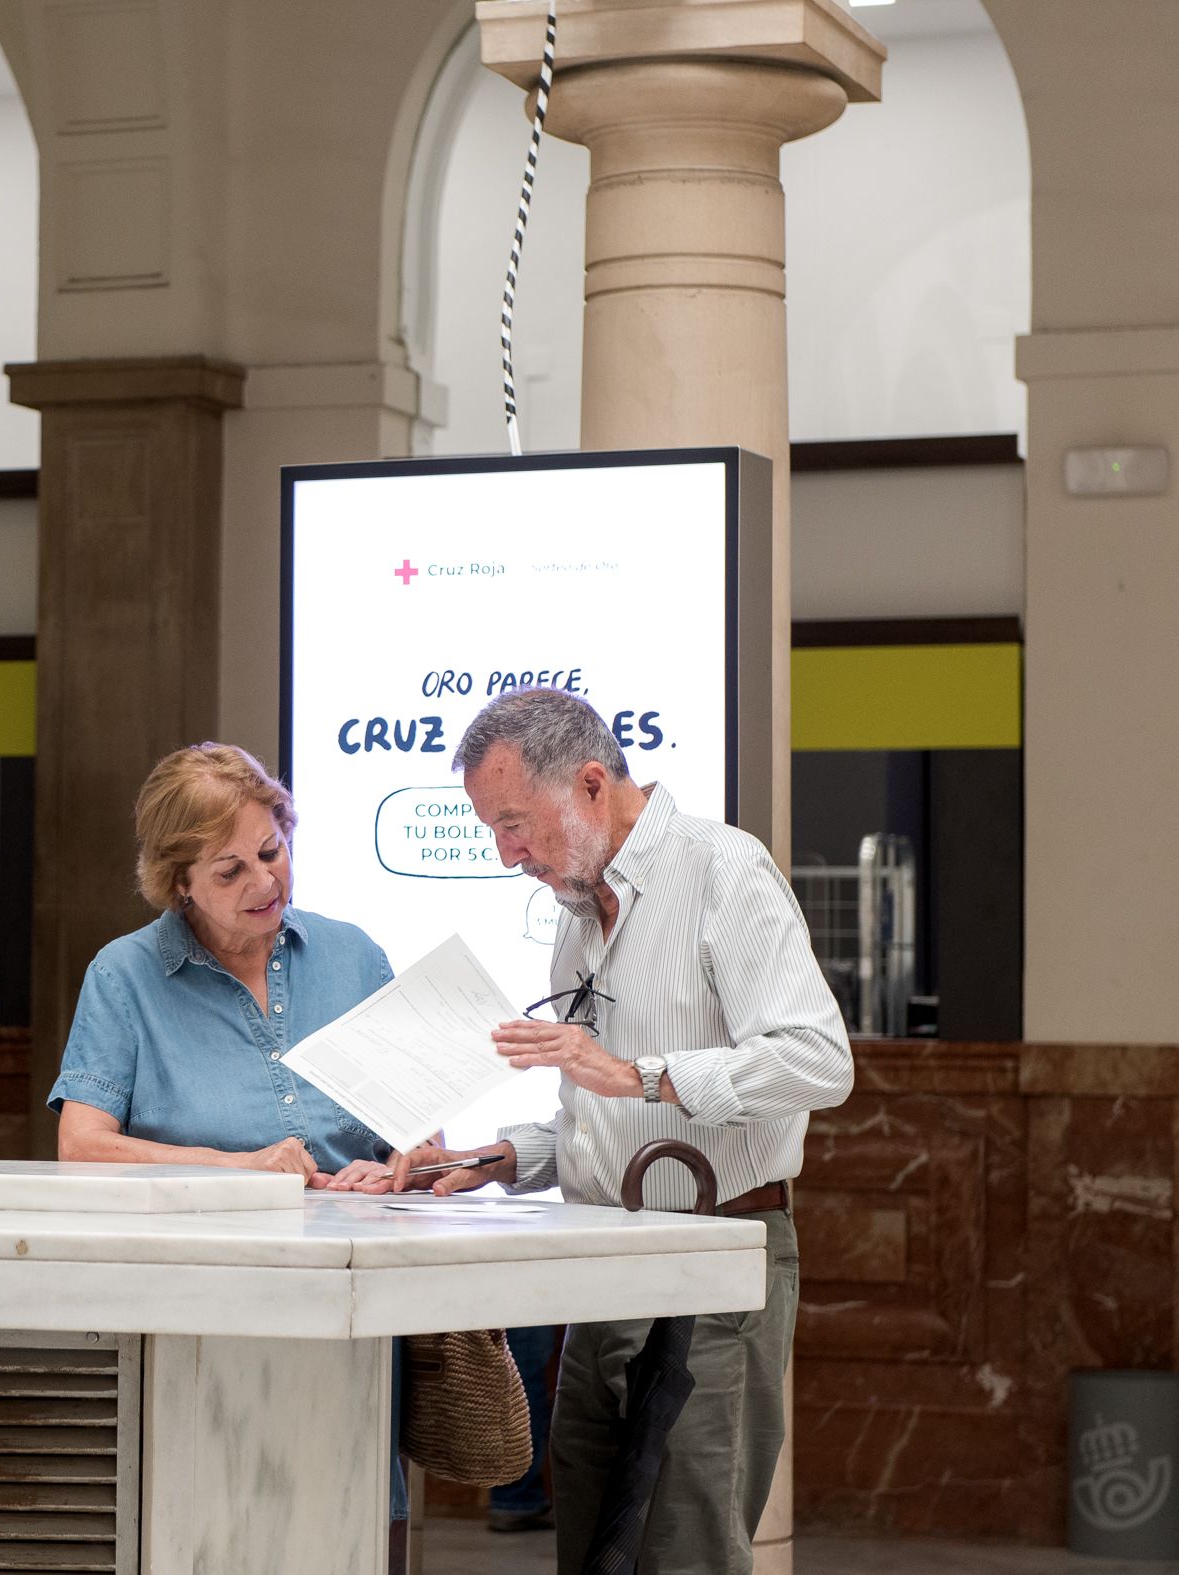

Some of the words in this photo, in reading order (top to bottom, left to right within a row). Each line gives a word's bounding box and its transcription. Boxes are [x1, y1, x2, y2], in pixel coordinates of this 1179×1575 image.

[427, 563, 465, 577] Cruz
[470, 561, 506, 578] Roja
[422, 670, 473, 698] ORO
[338, 716, 446, 755] CRUZ
[415, 803, 477, 818] COMP
[403, 825, 427, 839] TU
[434, 825, 493, 839] BOLET
[421, 847, 462, 861] POR
